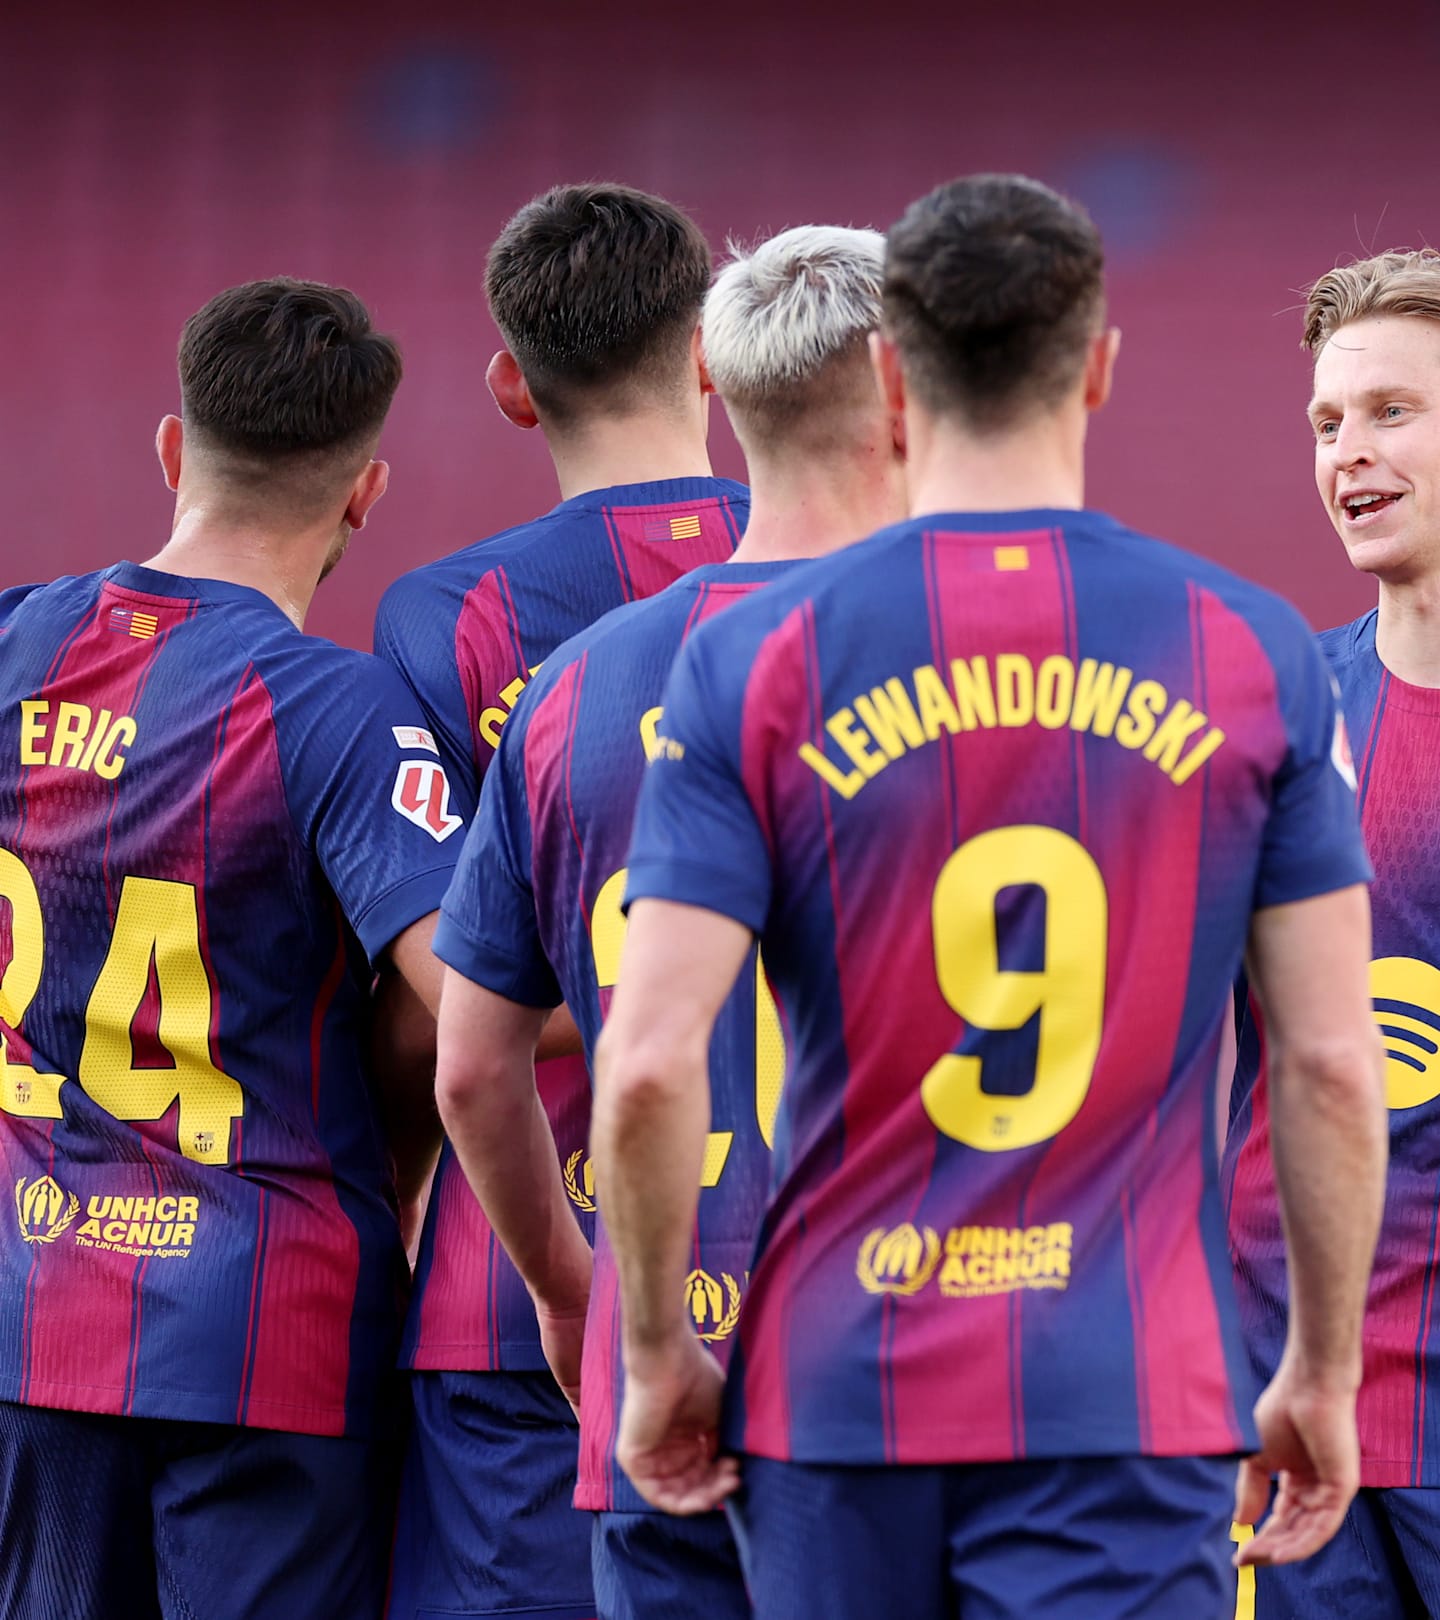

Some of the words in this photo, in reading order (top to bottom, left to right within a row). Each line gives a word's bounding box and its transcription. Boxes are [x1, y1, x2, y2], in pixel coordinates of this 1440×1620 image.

[20, 700, 137, 780] ERIC
[800, 654, 1224, 799] LEWANDOWSKI
[920, 824, 1108, 1153] 9
[87, 1196, 199, 1222] UNHCR
[75, 1235, 95, 1248] The
[95, 1240, 112, 1250] UN
[112, 1243, 154, 1257] Refugee
[154, 1248, 190, 1258] Agency
[76, 1218, 196, 1246] ACNUR
[944, 1221, 1073, 1256] UNHCR
[938, 1250, 1072, 1285] ACNUR
